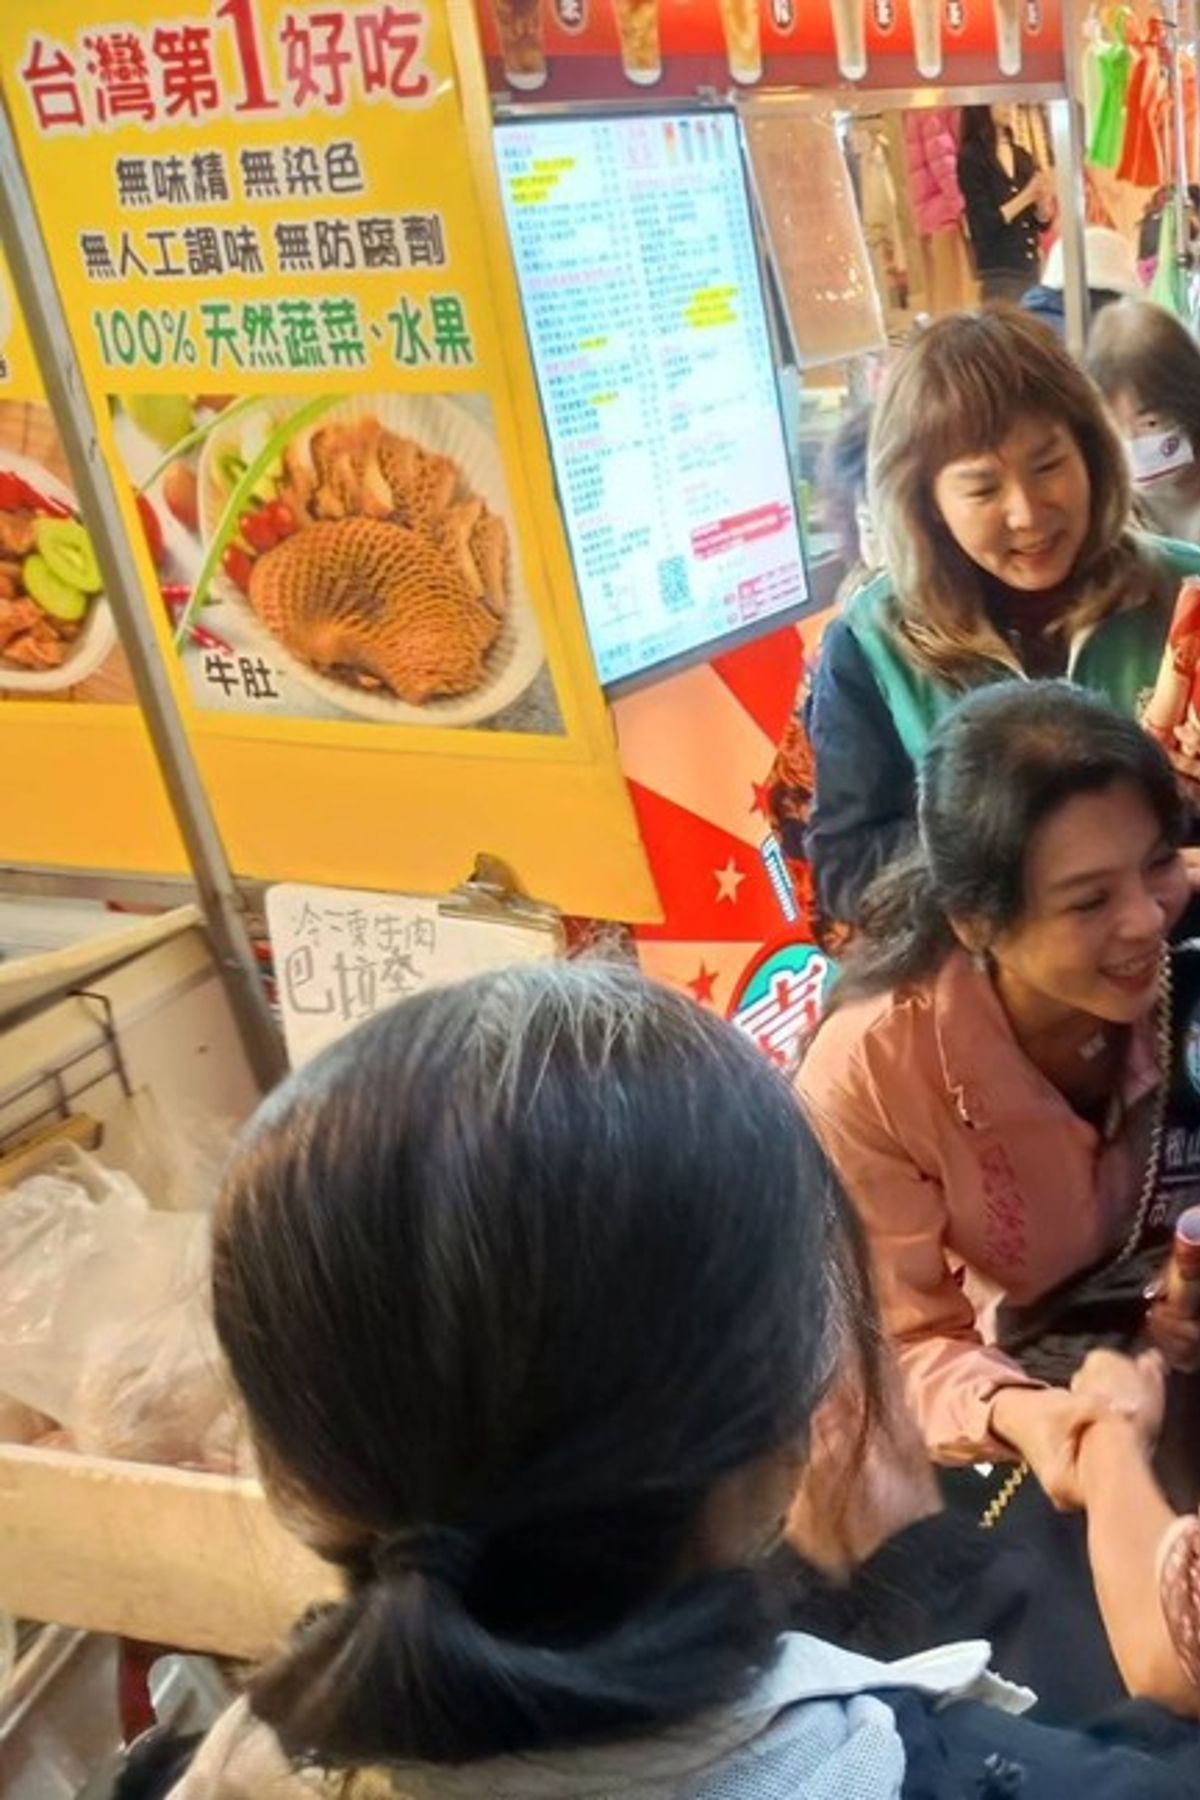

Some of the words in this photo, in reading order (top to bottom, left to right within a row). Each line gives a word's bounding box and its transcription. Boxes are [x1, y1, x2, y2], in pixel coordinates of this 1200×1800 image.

[22, 0, 430, 130] 台灣第1好吃
[116, 151, 228, 206] 無味精
[239, 142, 363, 197] 無染色
[80, 224, 264, 279] 無人工調味
[273, 213, 446, 272] 無防腐劑
[93, 309, 197, 367] 100%
[205, 655, 280, 699] 牛肚
